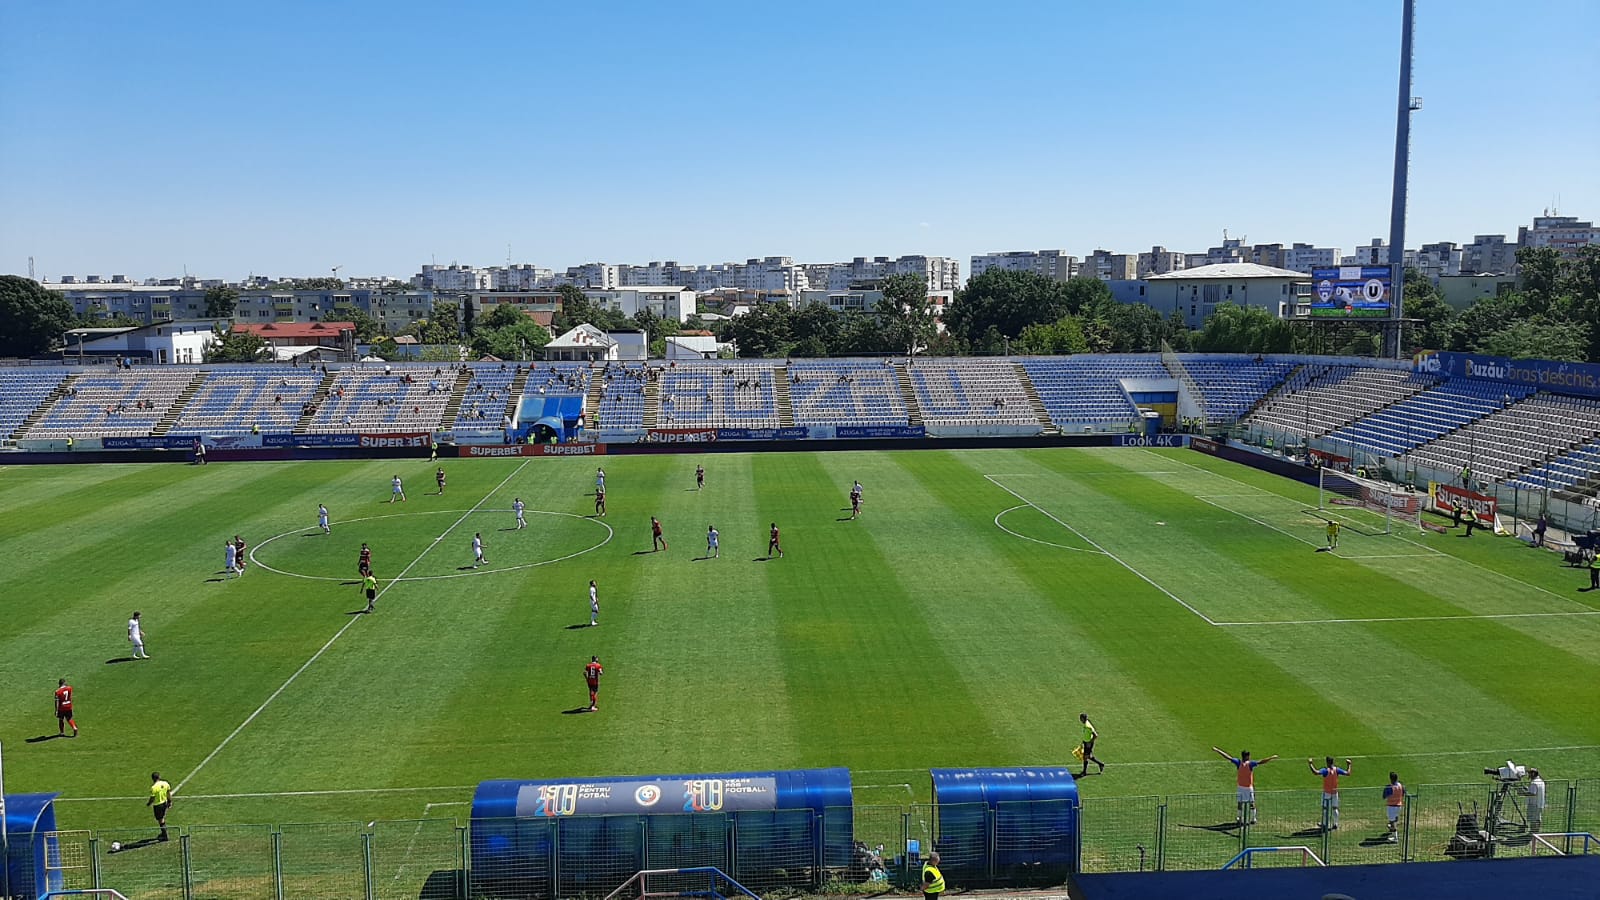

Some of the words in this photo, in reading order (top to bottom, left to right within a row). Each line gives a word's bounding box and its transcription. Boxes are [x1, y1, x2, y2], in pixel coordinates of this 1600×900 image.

[1368, 285, 1379, 298] U
[650, 431, 716, 443] SUPEBE
[1121, 435, 1152, 447] Look
[1156, 435, 1173, 447] 4K
[470, 445, 524, 456] SUPERBET
[543, 444, 597, 455] SUPERBET
[63, 690, 69, 701] 7
